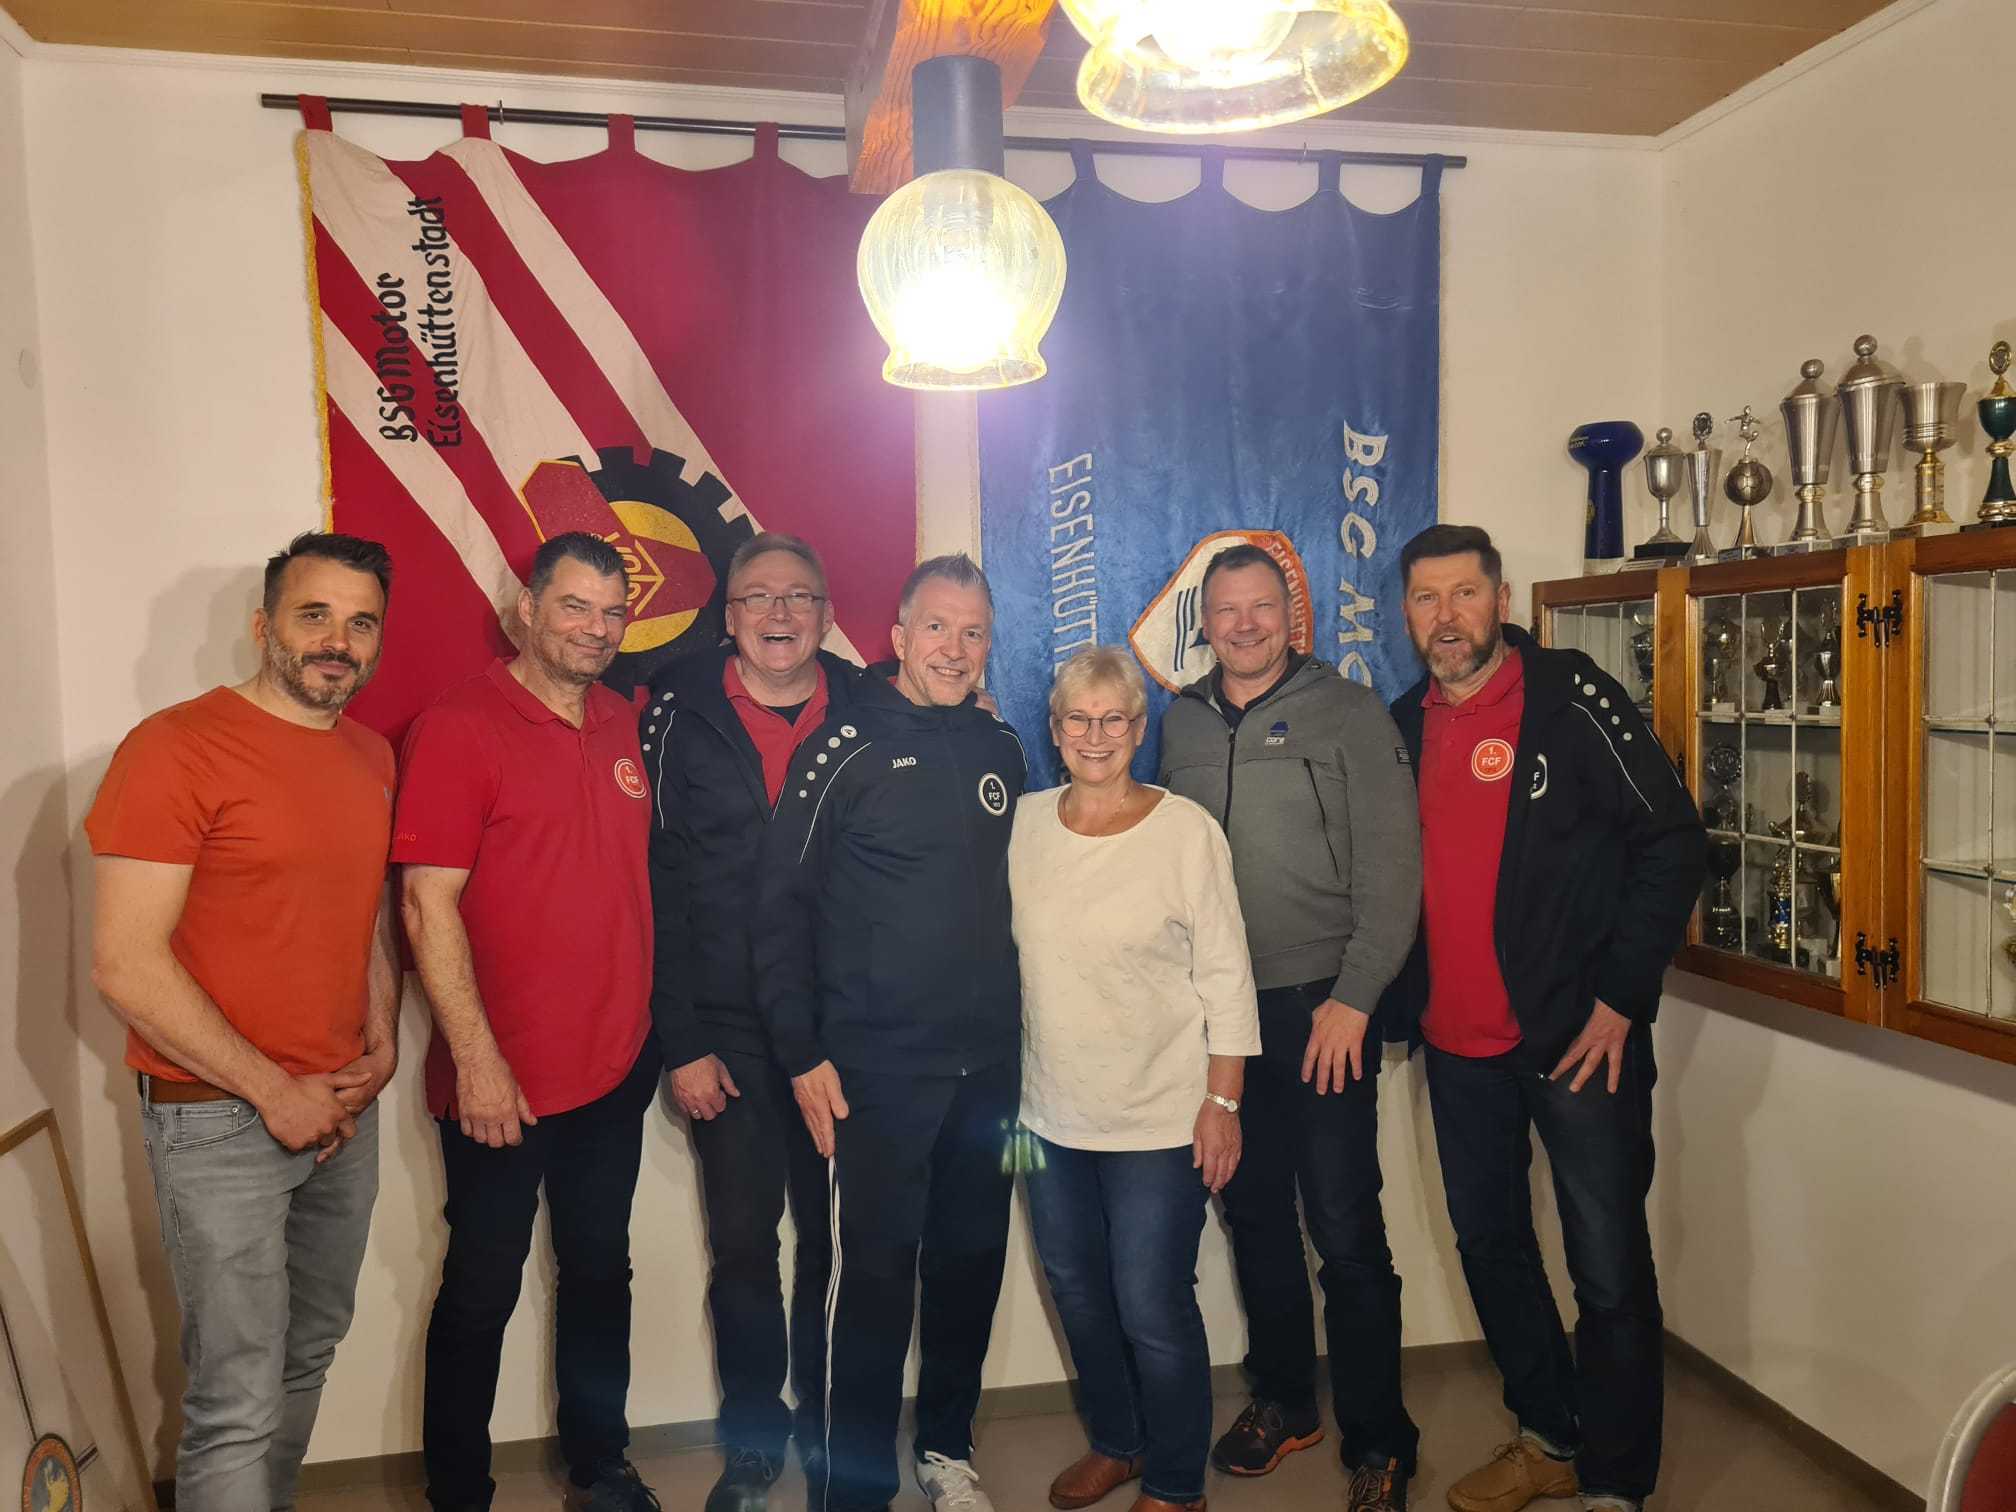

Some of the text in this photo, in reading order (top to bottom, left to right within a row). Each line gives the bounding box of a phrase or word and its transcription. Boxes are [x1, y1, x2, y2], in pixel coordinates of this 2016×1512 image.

[407, 196, 463, 447] Eisenhüttenstadt
[376, 385, 418, 442] BSG
[1340, 419, 1388, 560] BSG
[892, 756, 917, 769] JAKO
[1481, 756, 1501, 766] FCF
